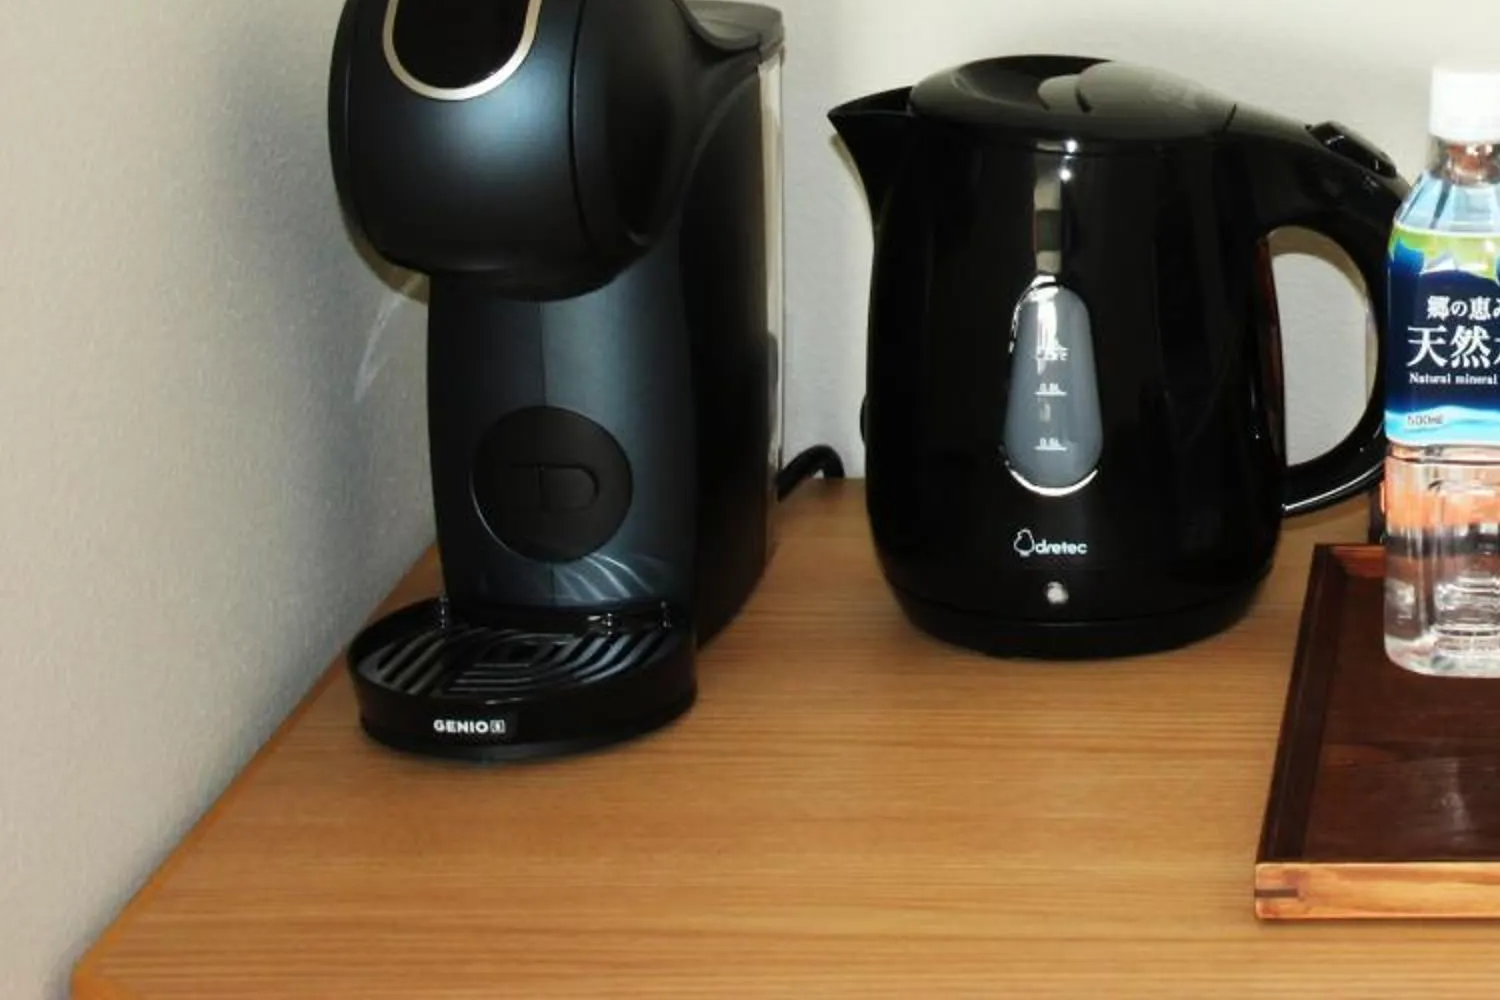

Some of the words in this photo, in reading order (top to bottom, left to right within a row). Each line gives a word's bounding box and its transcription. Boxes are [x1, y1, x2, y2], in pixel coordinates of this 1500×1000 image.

[1408, 372, 1451, 385] Natural
[1455, 373, 1498, 385] mineral
[1035, 538, 1088, 555] dretec
[433, 719, 489, 734] GENIO
